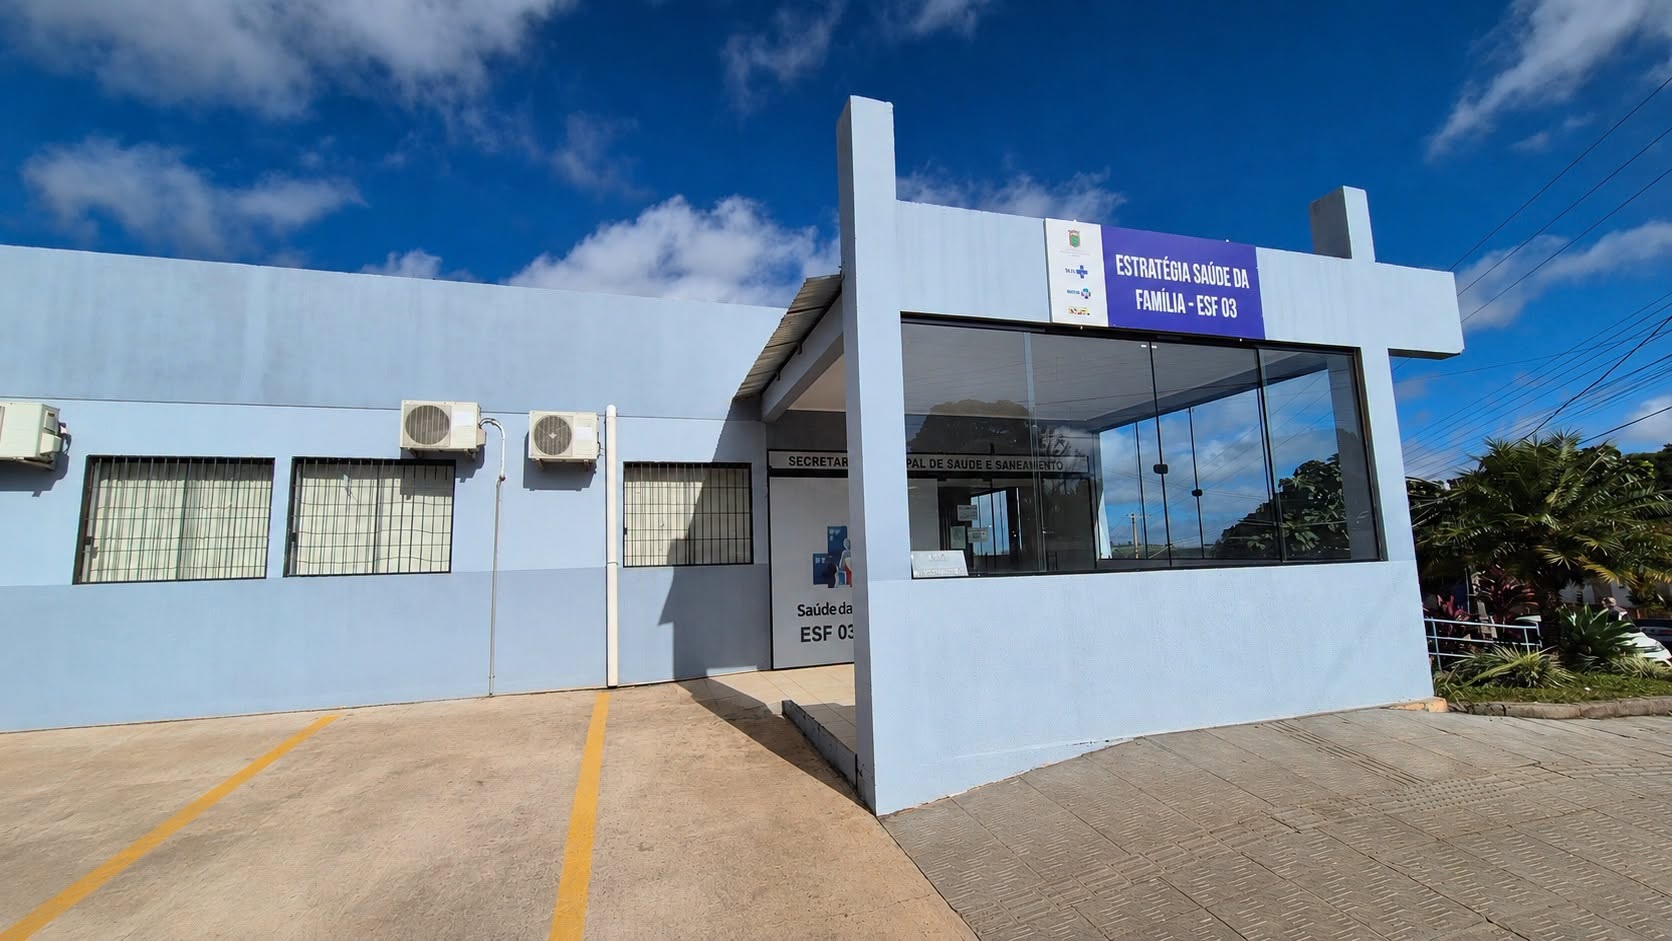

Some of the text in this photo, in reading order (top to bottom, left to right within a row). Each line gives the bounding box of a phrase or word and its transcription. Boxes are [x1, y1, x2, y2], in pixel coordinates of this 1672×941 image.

[1115, 254, 1250, 289] ESTRATÉGIA SAÚDE DA
[1135, 287, 1186, 314] FAMÍLIA
[1196, 294, 1218, 317] ESF
[1221, 297, 1238, 319] 03
[788, 455, 849, 468] SECRETAR
[929, 458, 944, 469] DE
[985, 459, 993, 470] E
[797, 601, 853, 617] Saúde da
[800, 625, 833, 643] ESF
